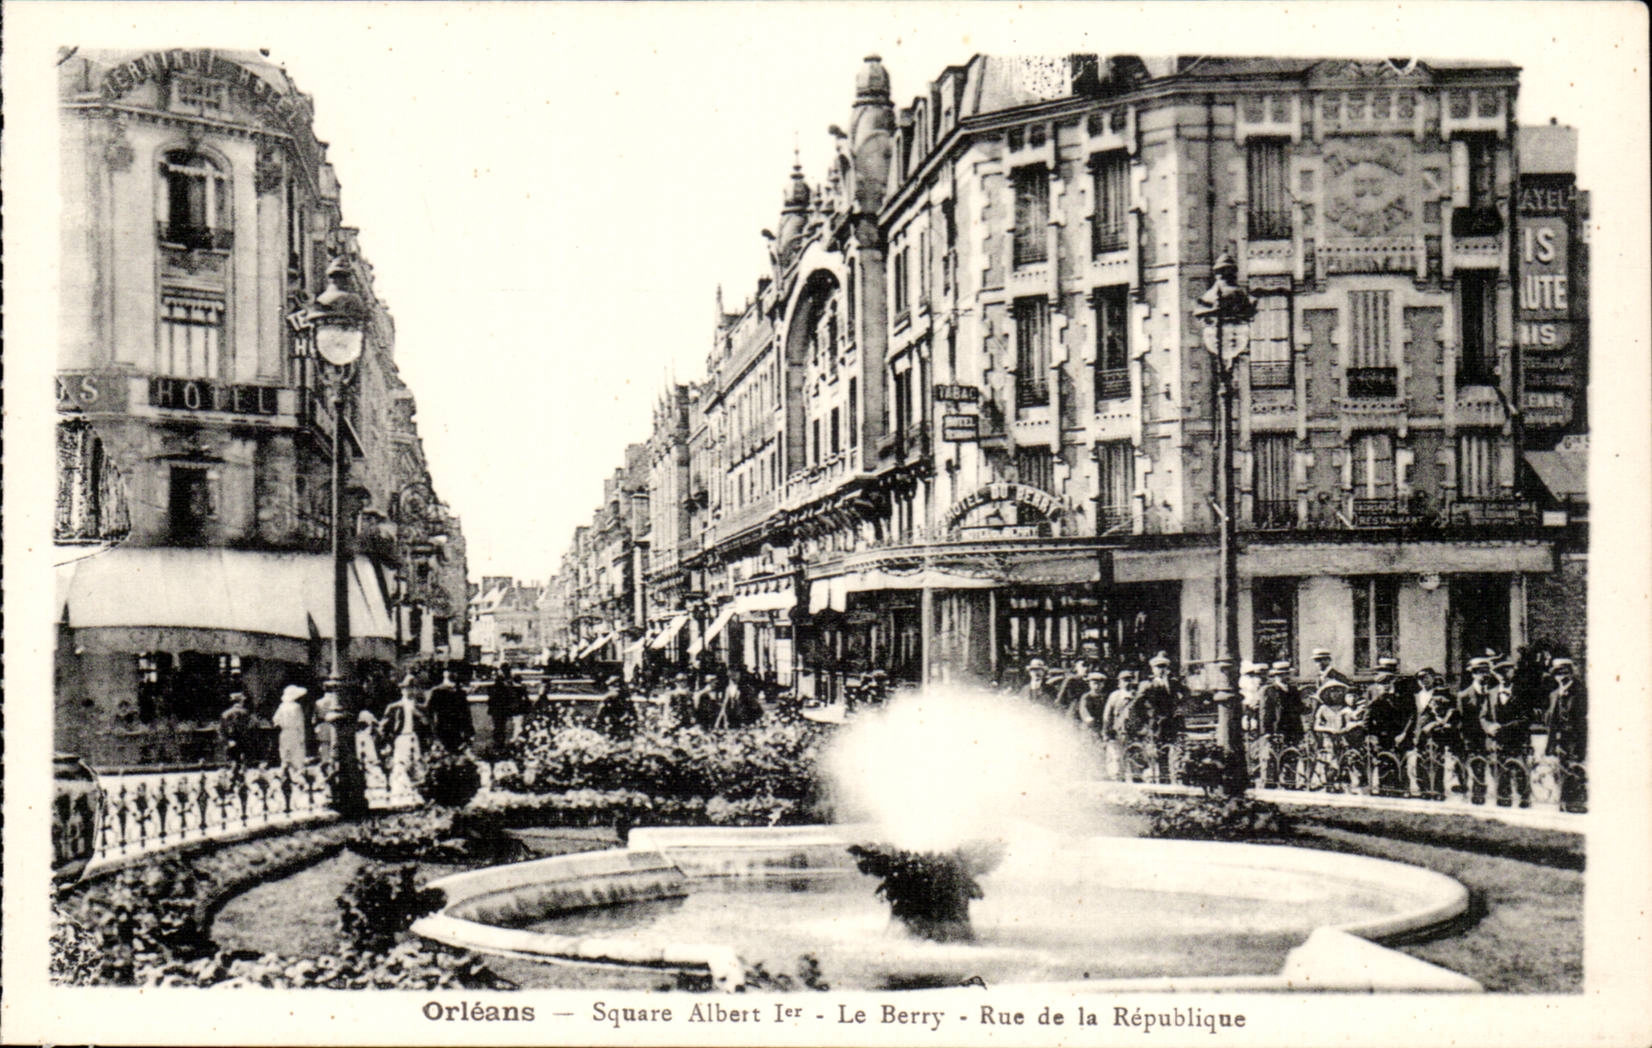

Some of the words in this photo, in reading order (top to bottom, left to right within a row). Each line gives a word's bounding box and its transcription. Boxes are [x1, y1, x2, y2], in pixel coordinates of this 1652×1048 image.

[157, 377, 276, 414] HOTEL
[939, 385, 977, 400] TABAC
[944, 492, 985, 521] HOTEL
[990, 484, 1009, 499] DU
[1016, 487, 1057, 519] BERRY
